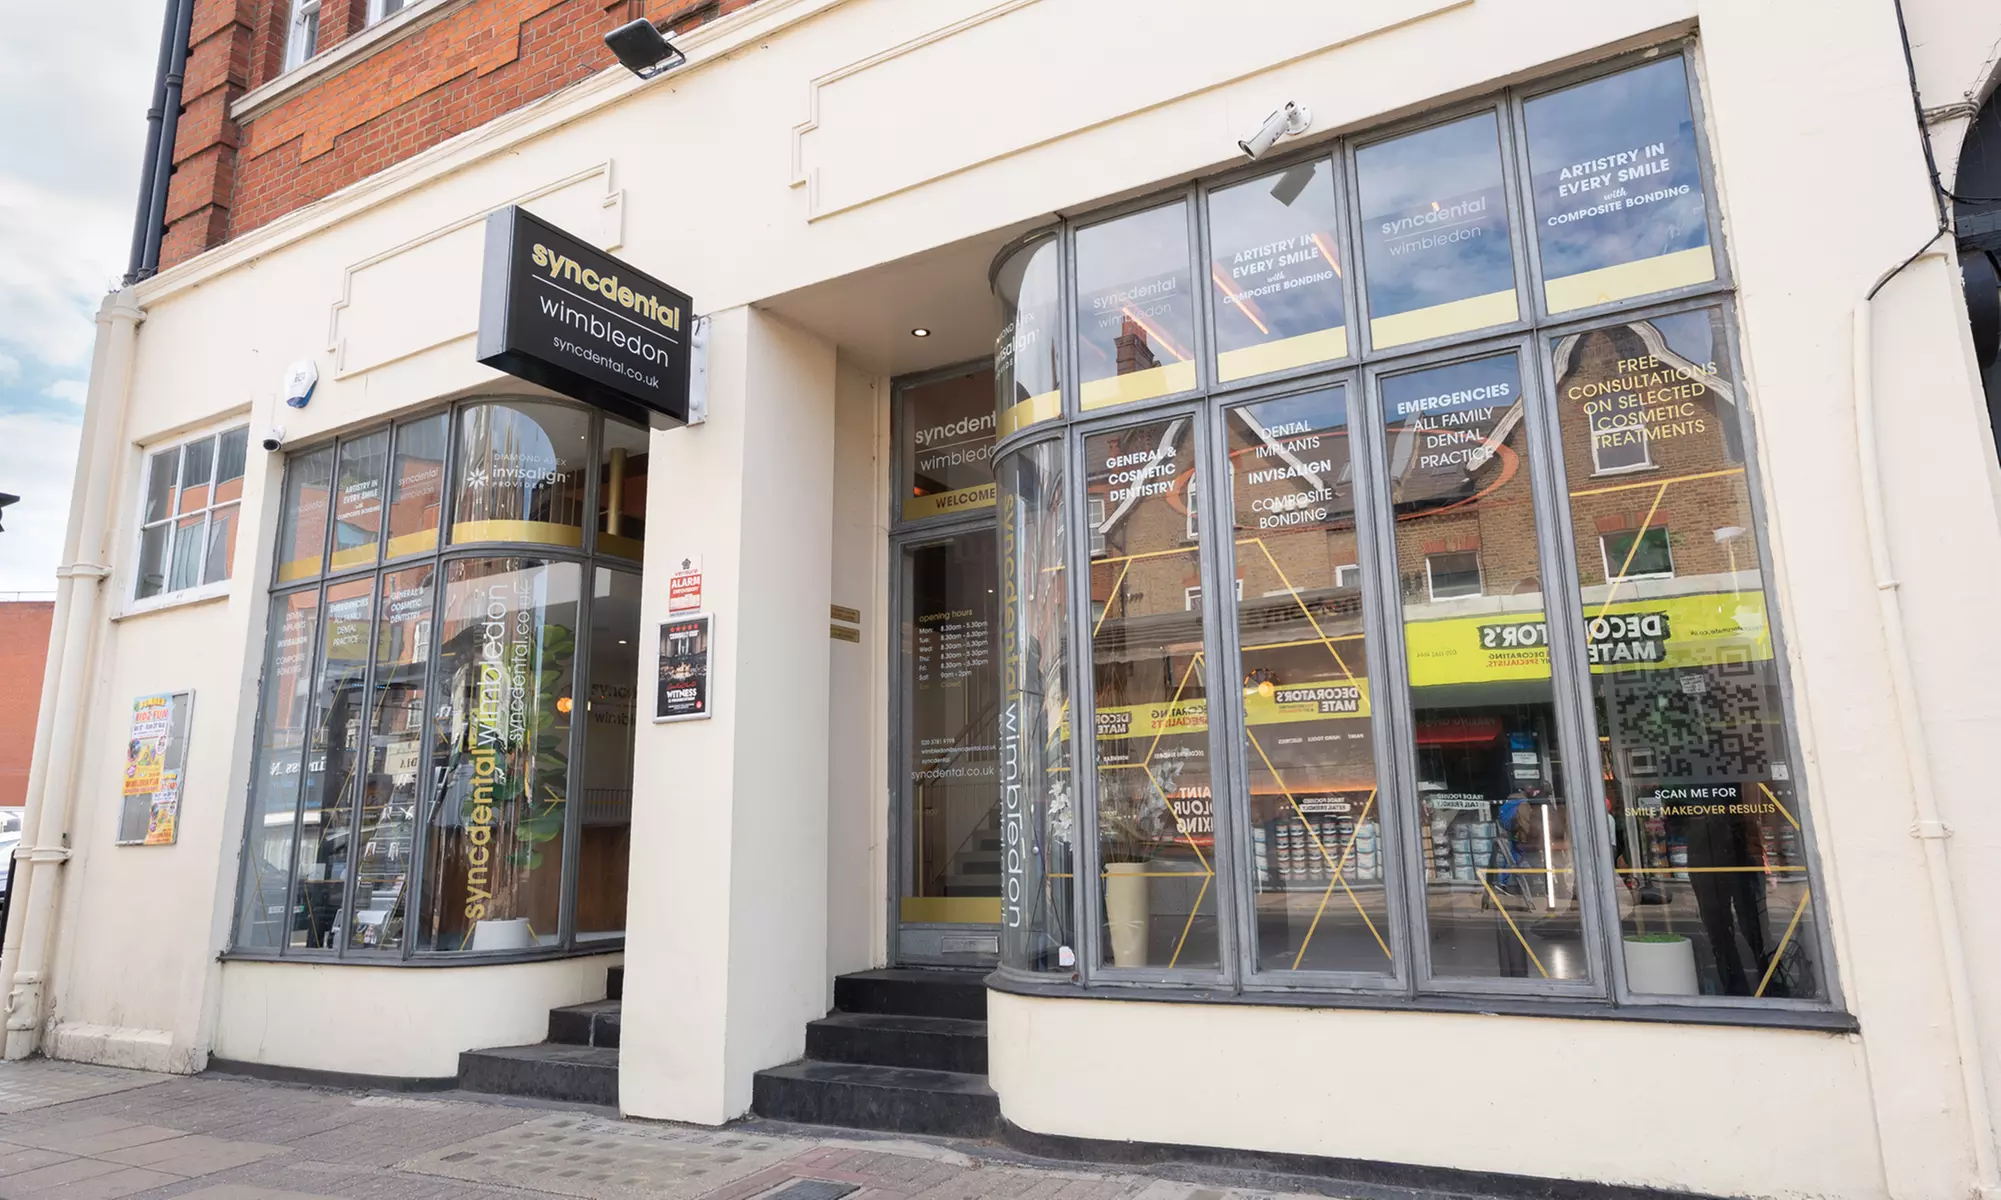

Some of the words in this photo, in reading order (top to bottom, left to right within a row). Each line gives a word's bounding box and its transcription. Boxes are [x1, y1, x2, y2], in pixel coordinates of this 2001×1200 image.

[1559, 149, 1639, 181] ARTISTRY
[1645, 142, 1665, 158] IN
[1559, 173, 1611, 198] EVERY
[1618, 158, 1670, 182] SMILE
[1547, 202, 1623, 227] COMPOSITE
[1626, 184, 1690, 208] BONDING
[1603, 187, 1628, 201] with
[1381, 196, 1486, 235] syncdental
[1233, 238, 1296, 264] ARTISTRY
[1300, 233, 1316, 247] IN
[1388, 225, 1481, 257] wimbledon
[1232, 258, 1276, 279] EVERY
[1279, 247, 1319, 267] SMILE
[532, 243, 680, 332] syncdental
[1223, 283, 1282, 305] COMPOSITE
[1284, 270, 1333, 289] BONDING
[1267, 272, 1285, 284] with
[1093, 277, 1176, 309] syncdental
[1099, 303, 1172, 329] wimbledon
[540, 295, 669, 368] wimbledon
[553, 336, 659, 389] syncdental.co.uk
[1617, 354, 1659, 374] FREE
[1567, 361, 1718, 401] CONSULTATIONS
[1397, 382, 1510, 415] EMERGENCIES
[1583, 401, 1612, 416] ON
[1617, 382, 1706, 410] SELECTED
[915, 410, 997, 446] syncdent
[1412, 417, 1439, 433] ALL
[1441, 406, 1494, 427] FAMILY
[1597, 402, 1695, 430] COSMETIC
[1261, 420, 1312, 440] DENTAL
[1426, 427, 1484, 449] DENTAL
[1593, 419, 1706, 450] TREATMENTS
[494, 453, 540, 462] DIAMOND
[920, 445, 997, 471] wimbledo
[1106, 450, 1164, 469] GENERAL
[1167, 446, 1177, 458] &
[1255, 436, 1320, 459] IMPLANTS
[1420, 446, 1494, 469] PRACTICE
[493, 465, 567, 485] invisalign
[1108, 463, 1176, 485] COSMETIC
[1248, 459, 1332, 485] INVISALIGN
[343, 494, 360, 504] EVERY
[361, 488, 378, 499] SMILE
[345, 483, 369, 494] ARTISTRY
[371, 479, 378, 487] IN
[935, 488, 996, 508] WELCOME
[1110, 480, 1176, 502] DENTISTRY
[1251, 488, 1333, 512] COMPOSITE
[1259, 507, 1327, 529] BONDING
[671, 576, 701, 589] ALARM
[391, 599, 422, 612] COSMETIC
[1004, 494, 1019, 701] syncdental
[919, 611, 950, 622] opening
[951, 609, 973, 618] hours
[477, 584, 508, 746] wimbledon
[509, 579, 532, 741] syncdental.co.uk
[667, 688, 697, 698] WITNESS
[911, 765, 995, 781] syncdental.co.uk
[1654, 789, 1687, 799] SCAN
[1690, 788, 1709, 798] ME
[1712, 787, 1737, 798] FOR
[1005, 702, 1022, 928] wimbledon
[1624, 806, 1657, 817] SMILE
[1660, 804, 1726, 816] MAKEOVER
[1729, 803, 1776, 815] RESULTS
[465, 748, 497, 921] syncdental
